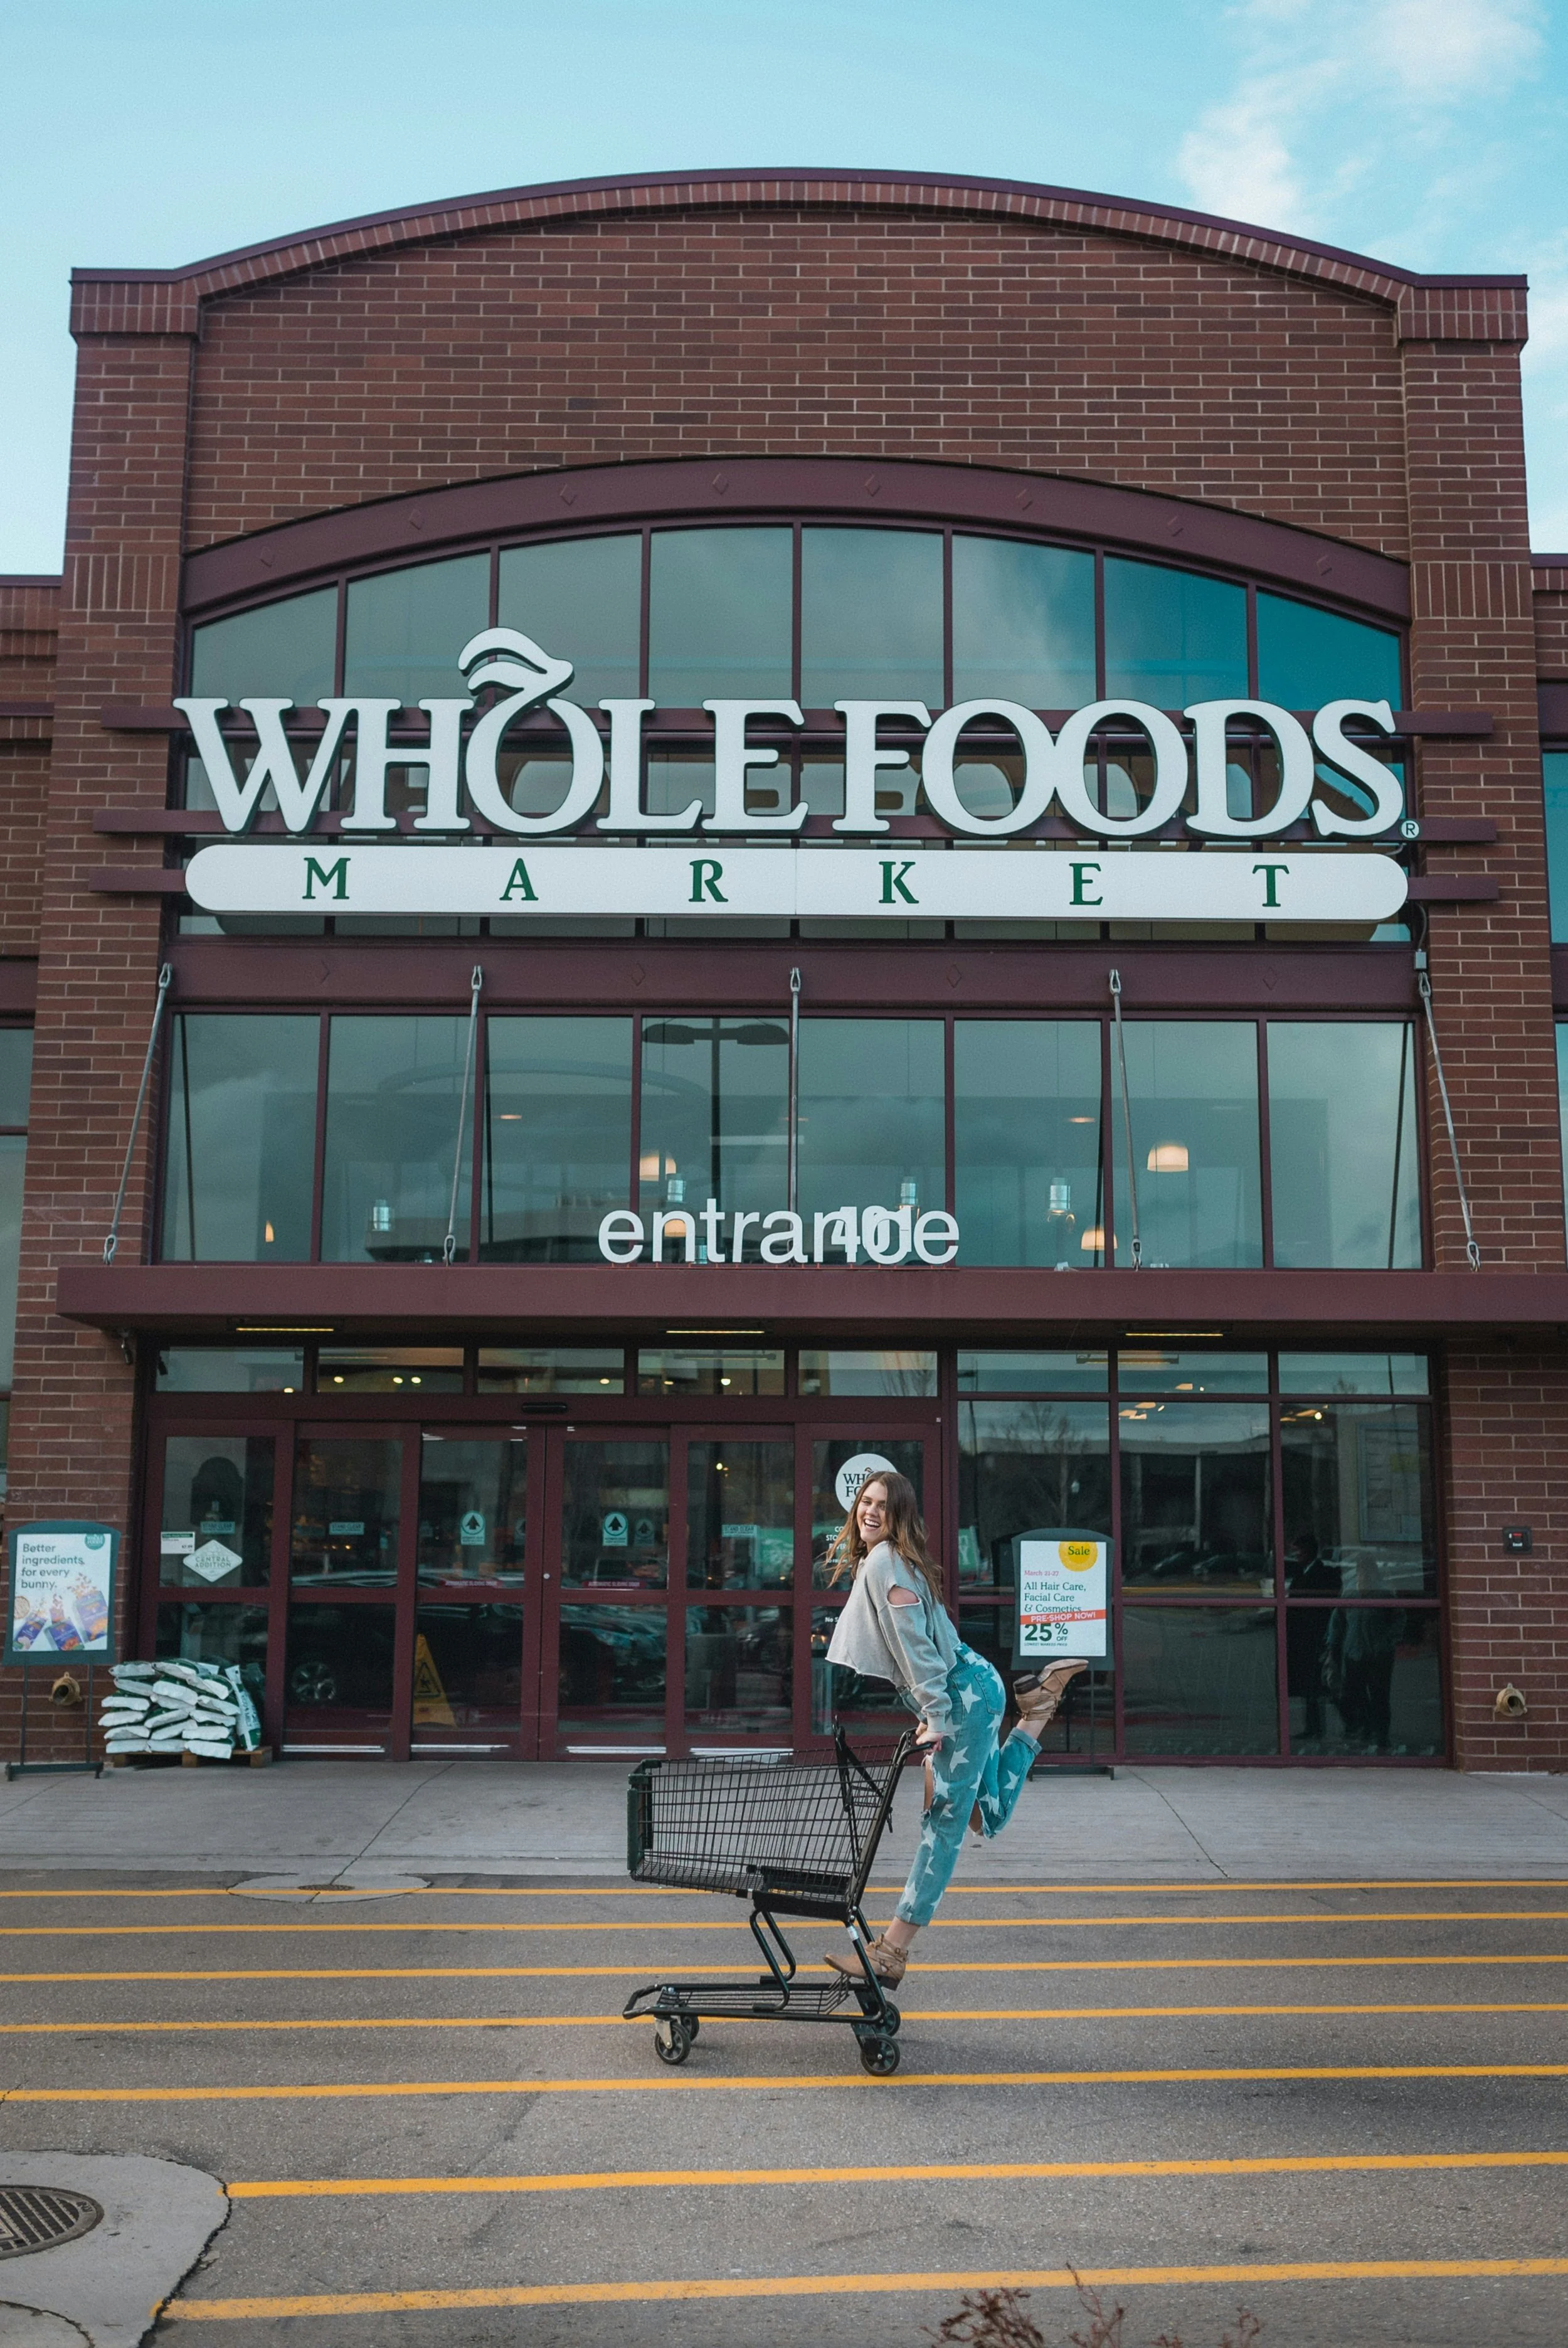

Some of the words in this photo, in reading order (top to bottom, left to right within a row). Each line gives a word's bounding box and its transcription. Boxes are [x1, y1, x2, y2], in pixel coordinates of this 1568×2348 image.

[172, 627, 810, 837] WHOLE
[832, 697, 1404, 838] FOODS
[302, 857, 1290, 908] MARKET
[598, 1198, 960, 1265] entrance
[23, 1543, 56, 1553] Better
[1068, 1546, 1090, 1556] Sale
[21, 1567, 36, 1576] for
[40, 1569, 70, 1578] every
[21, 1579, 58, 1590] bunny.
[1024, 1582, 1037, 1590] All
[1041, 1582, 1059, 1590] Hair
[1062, 1582, 1086, 1591] Care,
[1024, 1593, 1051, 1602] Facial
[1054, 1593, 1074, 1602] Care
[1024, 1604, 1033, 1612] &
[1036, 1604, 1082, 1613] Cosmetics
[1030, 1613, 1073, 1622] PRE-SHOP
[1074, 1612, 1096, 1620] NOW!
